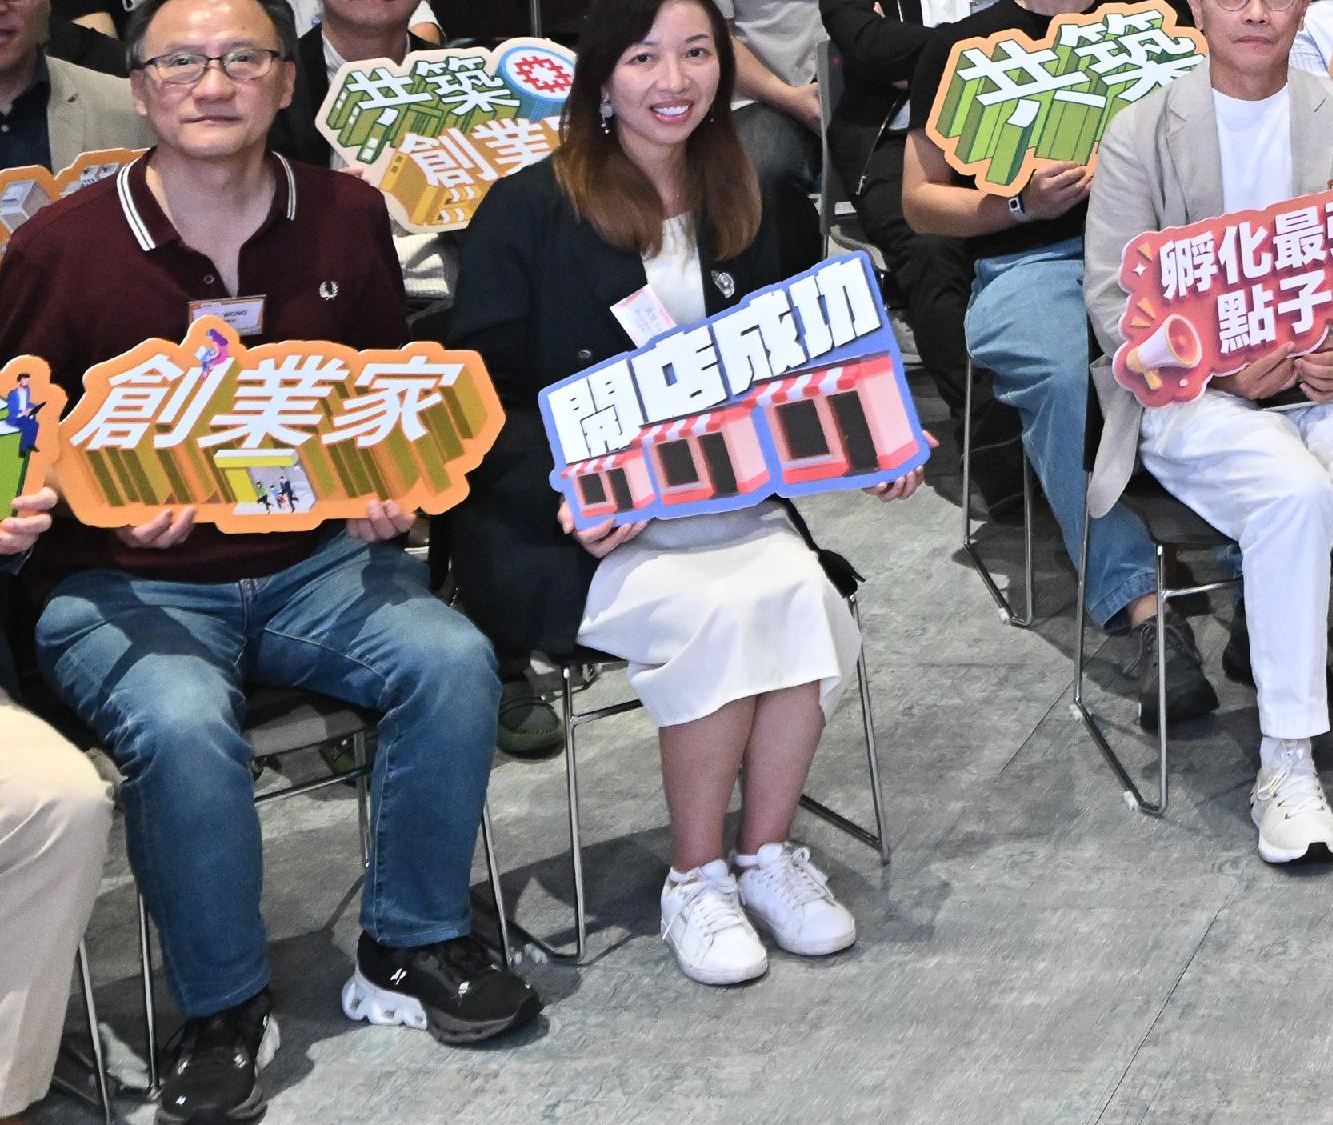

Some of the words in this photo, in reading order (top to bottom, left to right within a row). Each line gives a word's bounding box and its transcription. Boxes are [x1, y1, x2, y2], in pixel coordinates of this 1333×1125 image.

[347, 55, 520, 128] 共築
[957, 9, 1209, 128] 共築
[400, 117, 566, 188] 創業
[70, 356, 466, 450] 創業家
[549, 261, 882, 460] 開店成功
